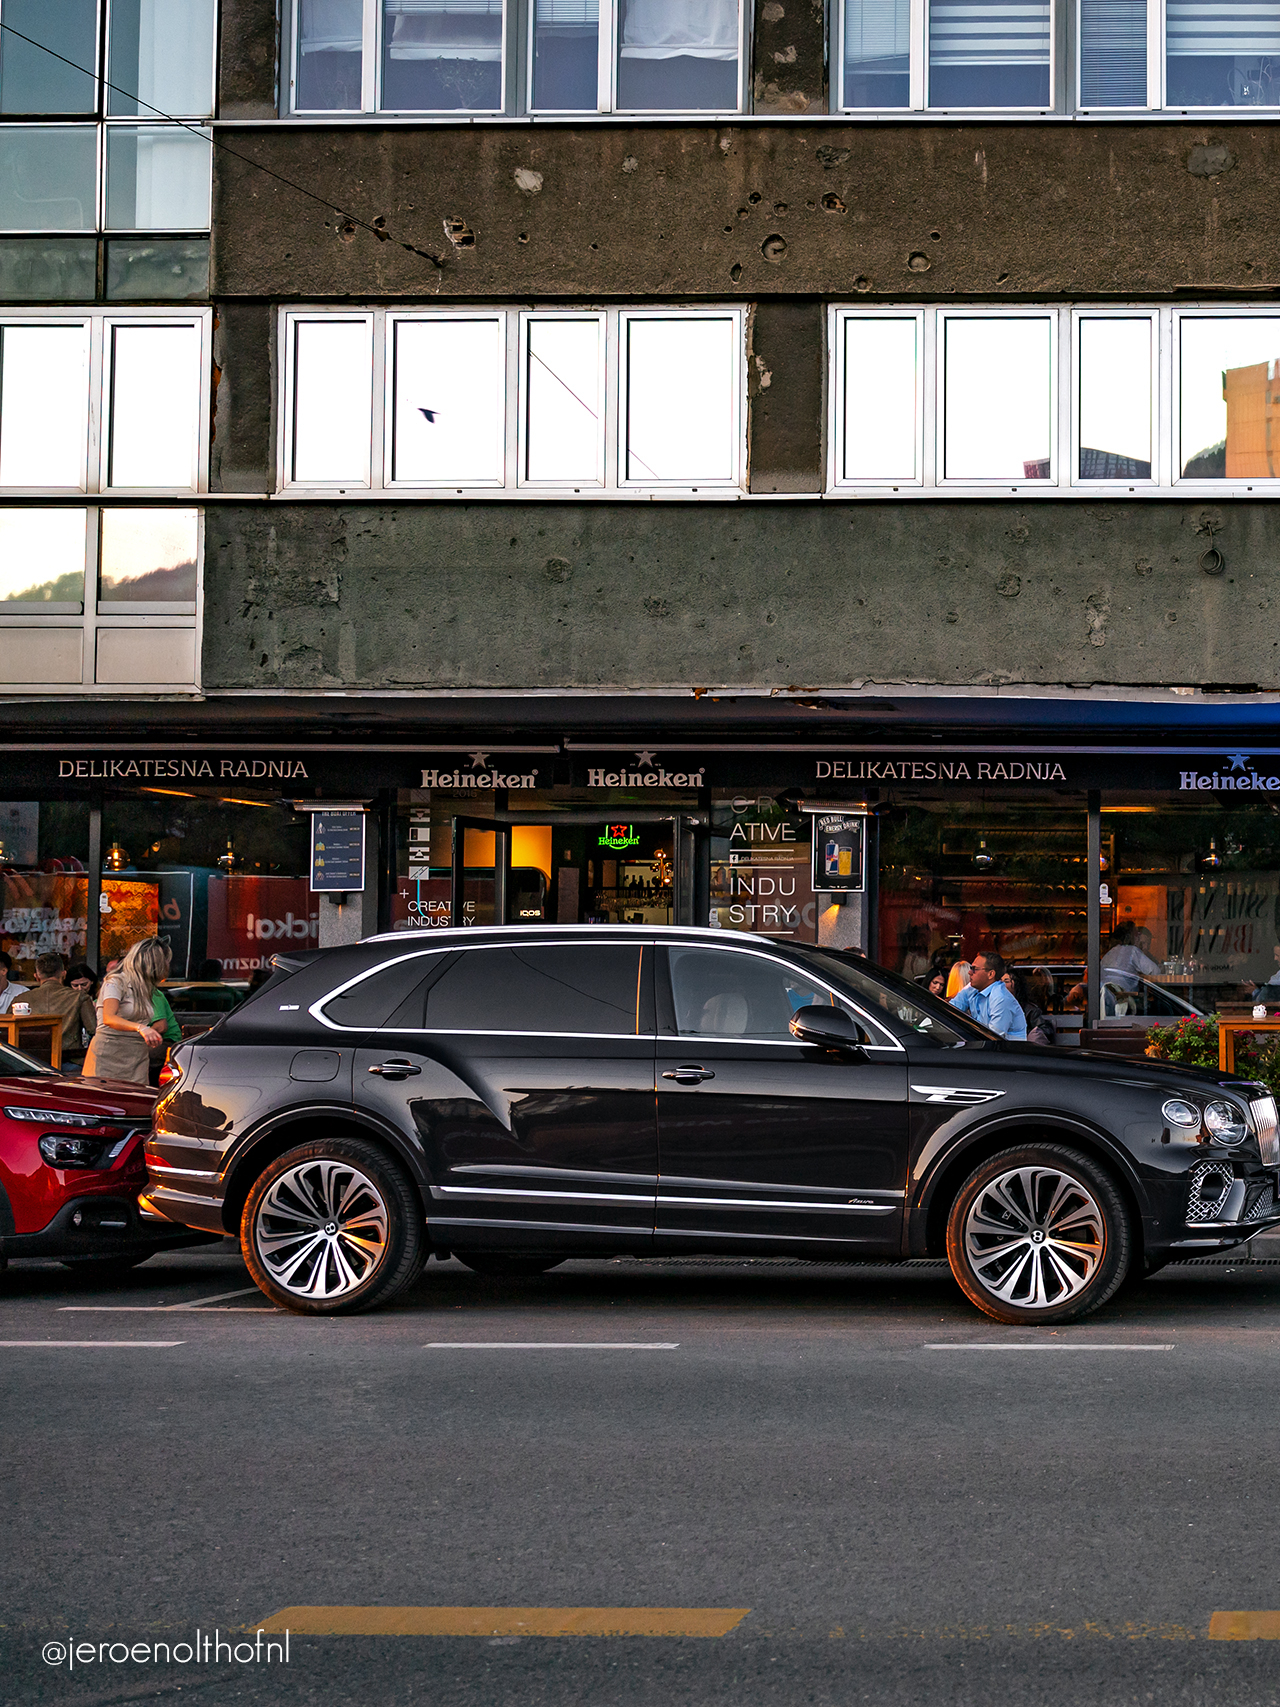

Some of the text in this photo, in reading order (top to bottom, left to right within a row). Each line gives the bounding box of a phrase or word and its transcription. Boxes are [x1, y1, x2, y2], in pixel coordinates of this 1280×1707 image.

[58, 760, 309, 778] DELIKATESNA RADNJA
[587, 768, 704, 788] Heineken
[815, 761, 1067, 781] DELIKATESNA RADNJA
[420, 769, 536, 789] Heineken
[598, 836, 639, 846] Heineken
[729, 822, 796, 841] ATIVE
[730, 877, 796, 896] INDU
[519, 909, 541, 917] IQOS
[729, 904, 797, 923] STRY
